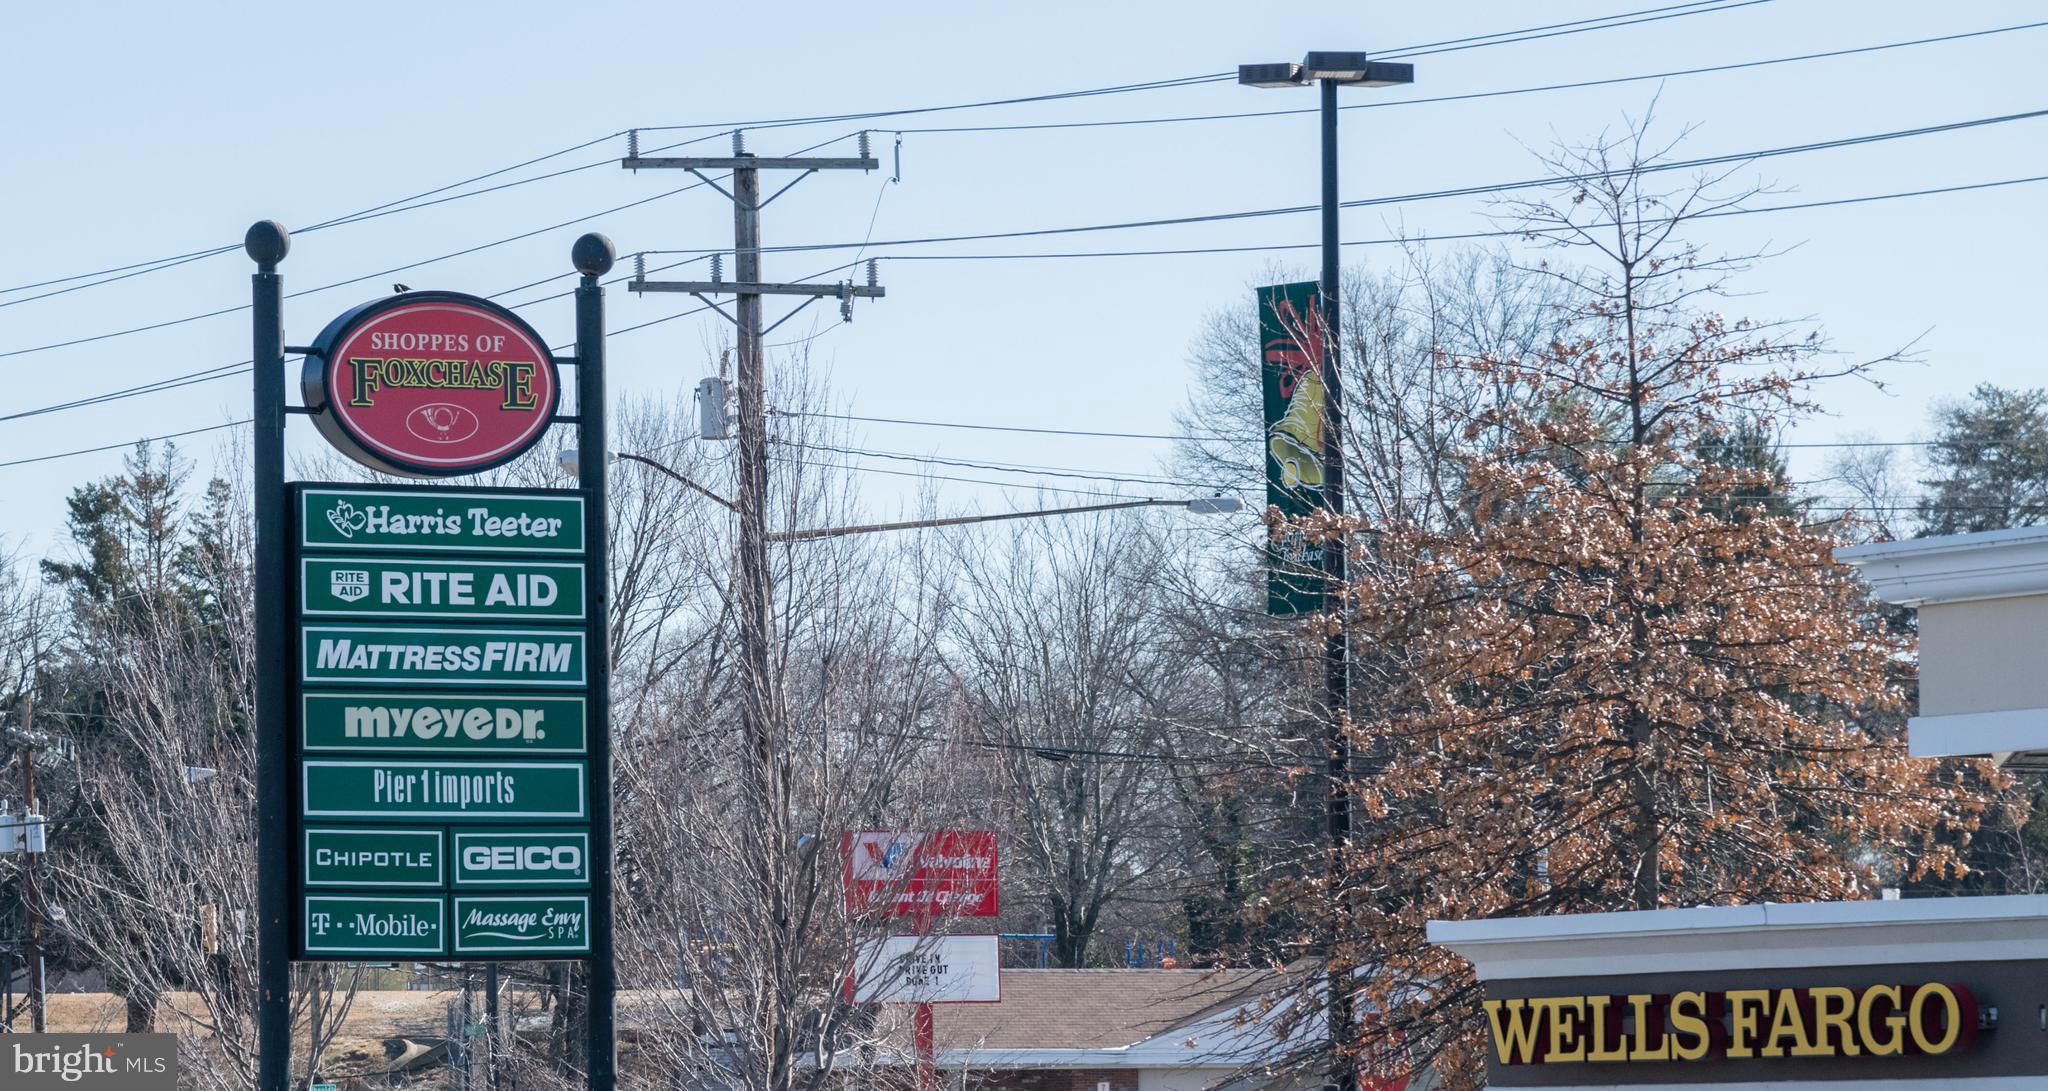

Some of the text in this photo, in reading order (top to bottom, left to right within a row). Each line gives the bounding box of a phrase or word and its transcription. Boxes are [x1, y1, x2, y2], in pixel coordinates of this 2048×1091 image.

[371, 332, 506, 352] SHOPPES OF
[349, 357, 539, 410] FOXCHASE
[366, 505, 562, 538] Harris Teeter
[335, 572, 365, 583] RITE
[381, 571, 558, 607] RITE AID
[339, 585, 363, 597] AID
[374, 769, 515, 809] Pier 1 imports
[316, 848, 432, 867] CHIPOTLE
[463, 846, 581, 871] GEICO
[462, 907, 581, 932] Massage Envy
[548, 926, 574, 939] SPA
[898, 964, 927, 975] RIVE
[1483, 991, 1711, 1064] WELLS
[1726, 982, 1961, 1058] FARGO
